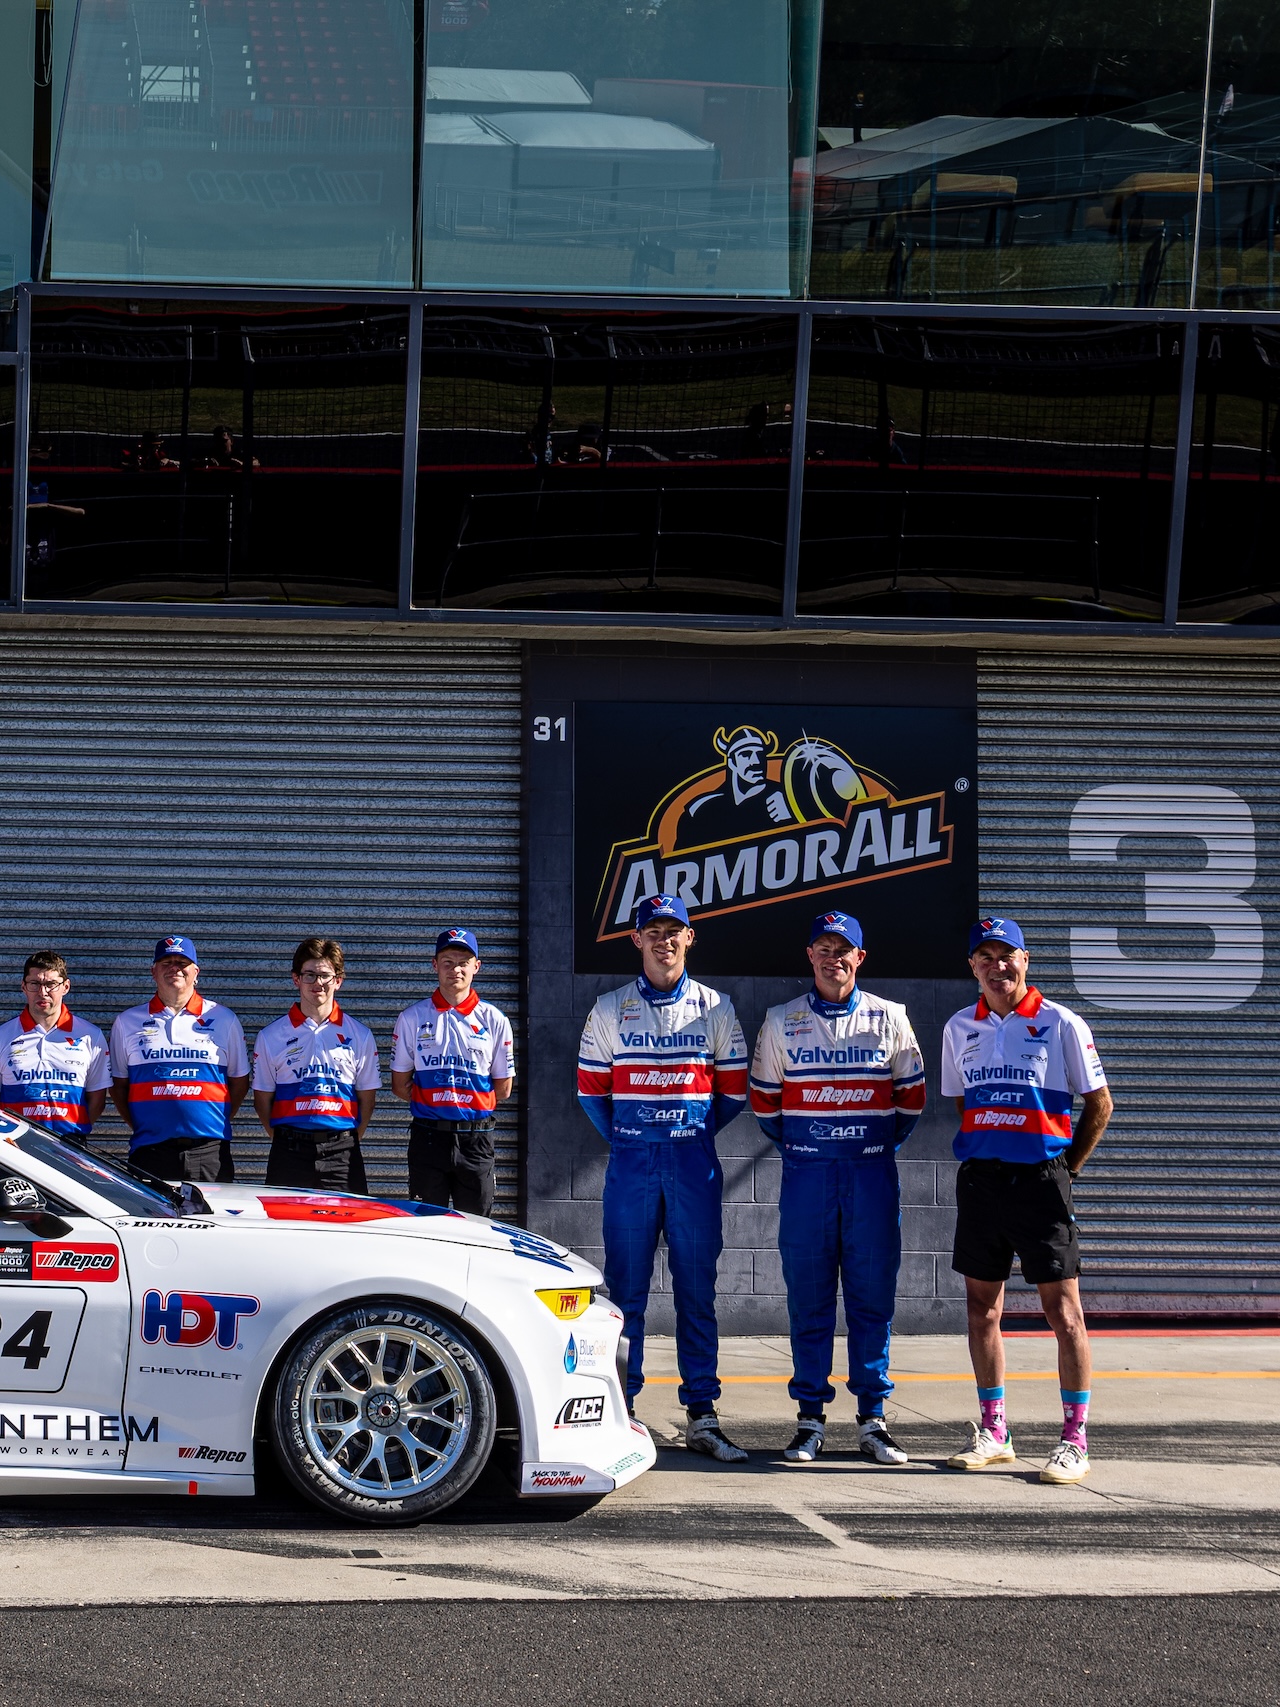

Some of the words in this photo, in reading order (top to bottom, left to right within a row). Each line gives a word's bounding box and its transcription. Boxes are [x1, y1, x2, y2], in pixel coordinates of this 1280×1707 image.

[533, 716, 566, 741] 31
[1068, 784, 1265, 1013] 3
[619, 1031, 708, 1048] Valvoline
[1023, 1037, 1049, 1045] Valvoline
[141, 1047, 210, 1060] Valvoline
[786, 1046, 887, 1065] Valvoline
[12, 1068, 79, 1082] Valvoline
[170, 1068, 200, 1077] AAT
[644, 1070, 696, 1088] Repco
[963, 1065, 1038, 1083] Valvoline
[163, 1083, 203, 1097] Repco
[816, 1086, 875, 1106] Repco
[990, 1091, 1024, 1102] AAT
[307, 1098, 343, 1112] Repco
[655, 1109, 687, 1119] AAT
[982, 1110, 1027, 1126] Repco
[669, 1128, 697, 1138] HERNE
[830, 1125, 868, 1137] AAT
[131, 1221, 216, 1230] DUNLOP
[56, 1250, 116, 1272] Repco
[142, 1289, 261, 1350] HDT
[384, 1310, 476, 1373] DUNLOP
[139, 1365, 243, 1381] CHEVROLET
[570, 1398, 603, 1423] HCC
[0, 1446, 128, 1457] WORKWEAR
[196, 1444, 247, 1464] Repco
[532, 1474, 587, 1488] MOUNTAIN
